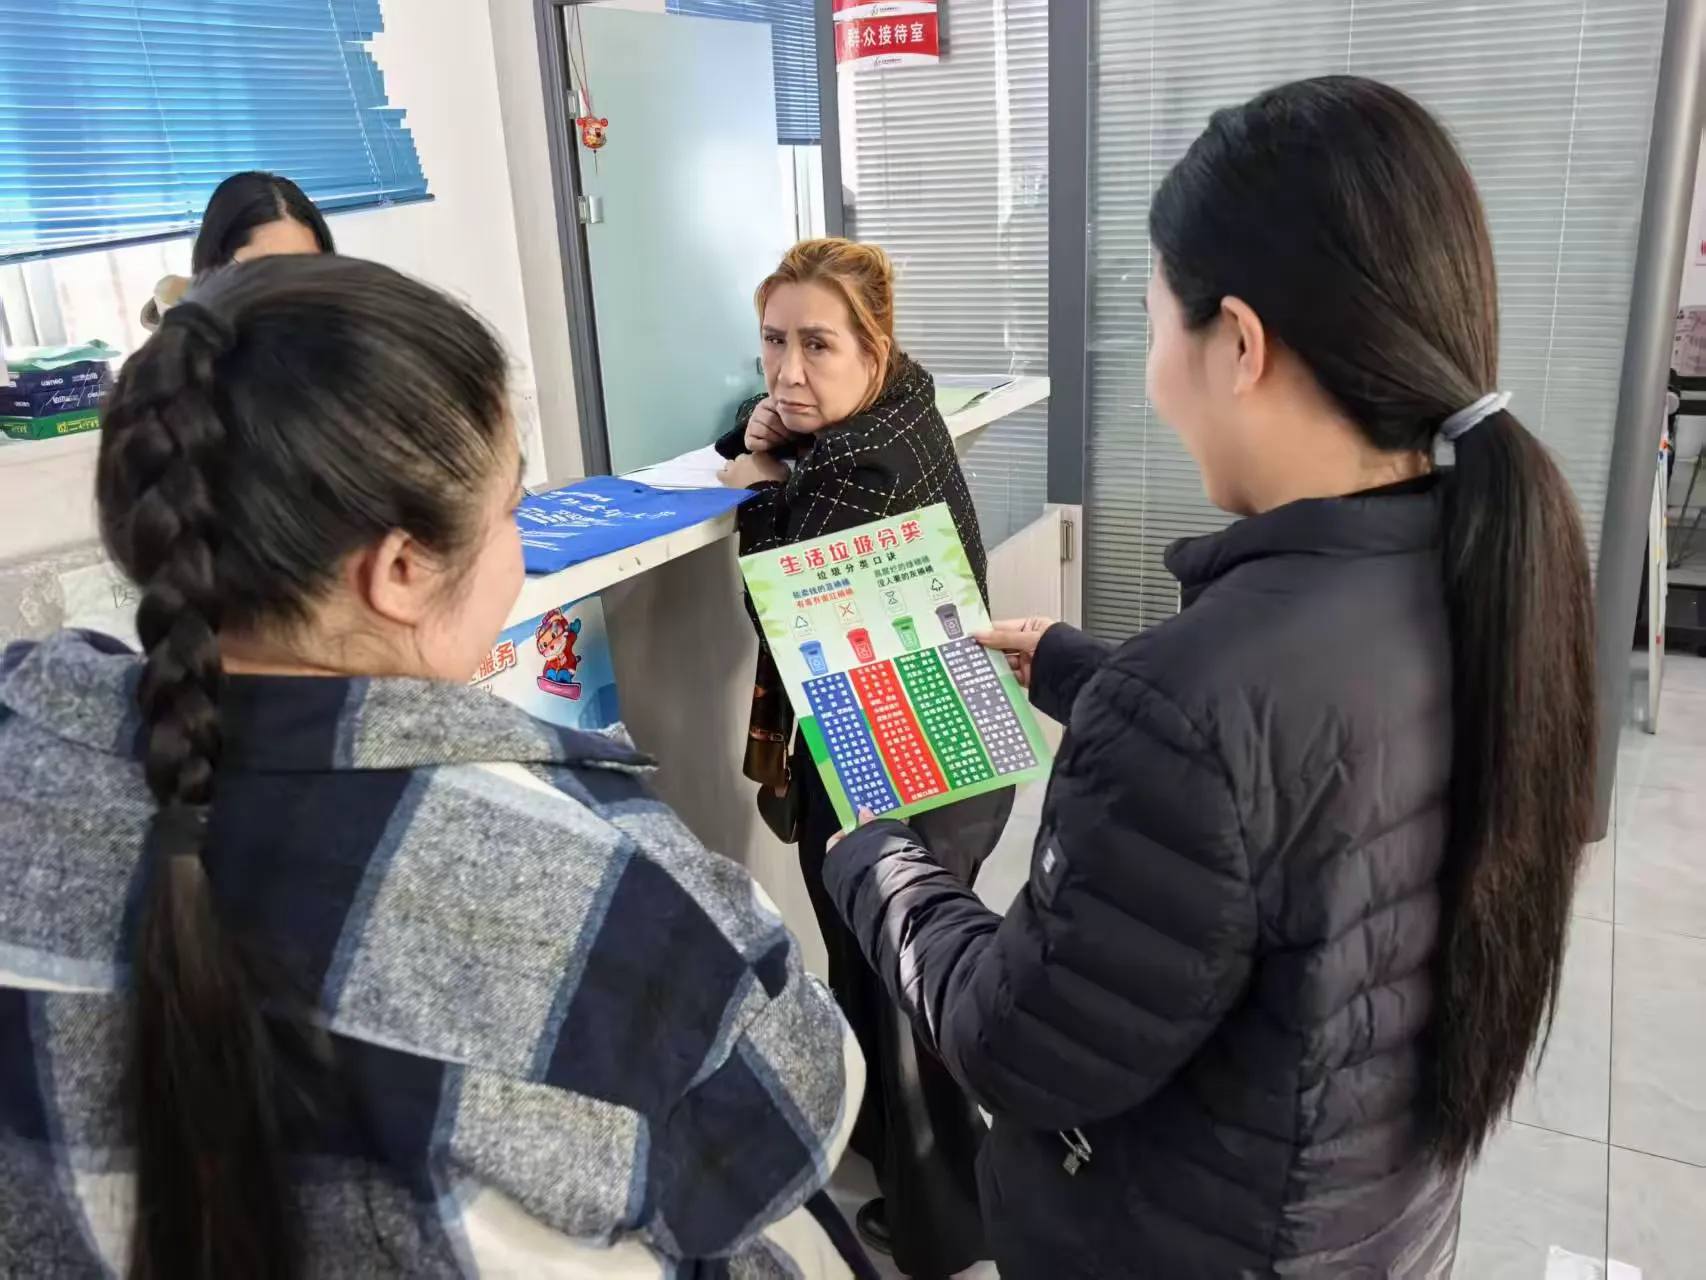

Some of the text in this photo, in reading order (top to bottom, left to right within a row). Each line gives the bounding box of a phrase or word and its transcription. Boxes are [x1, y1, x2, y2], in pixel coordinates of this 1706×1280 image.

[847, 22, 924, 47] 群众接待室
[779, 519, 923, 577] 生活垃圾分类
[817, 553, 898, 581] 垃圾分类口诀
[468, 641, 516, 681] 服务
